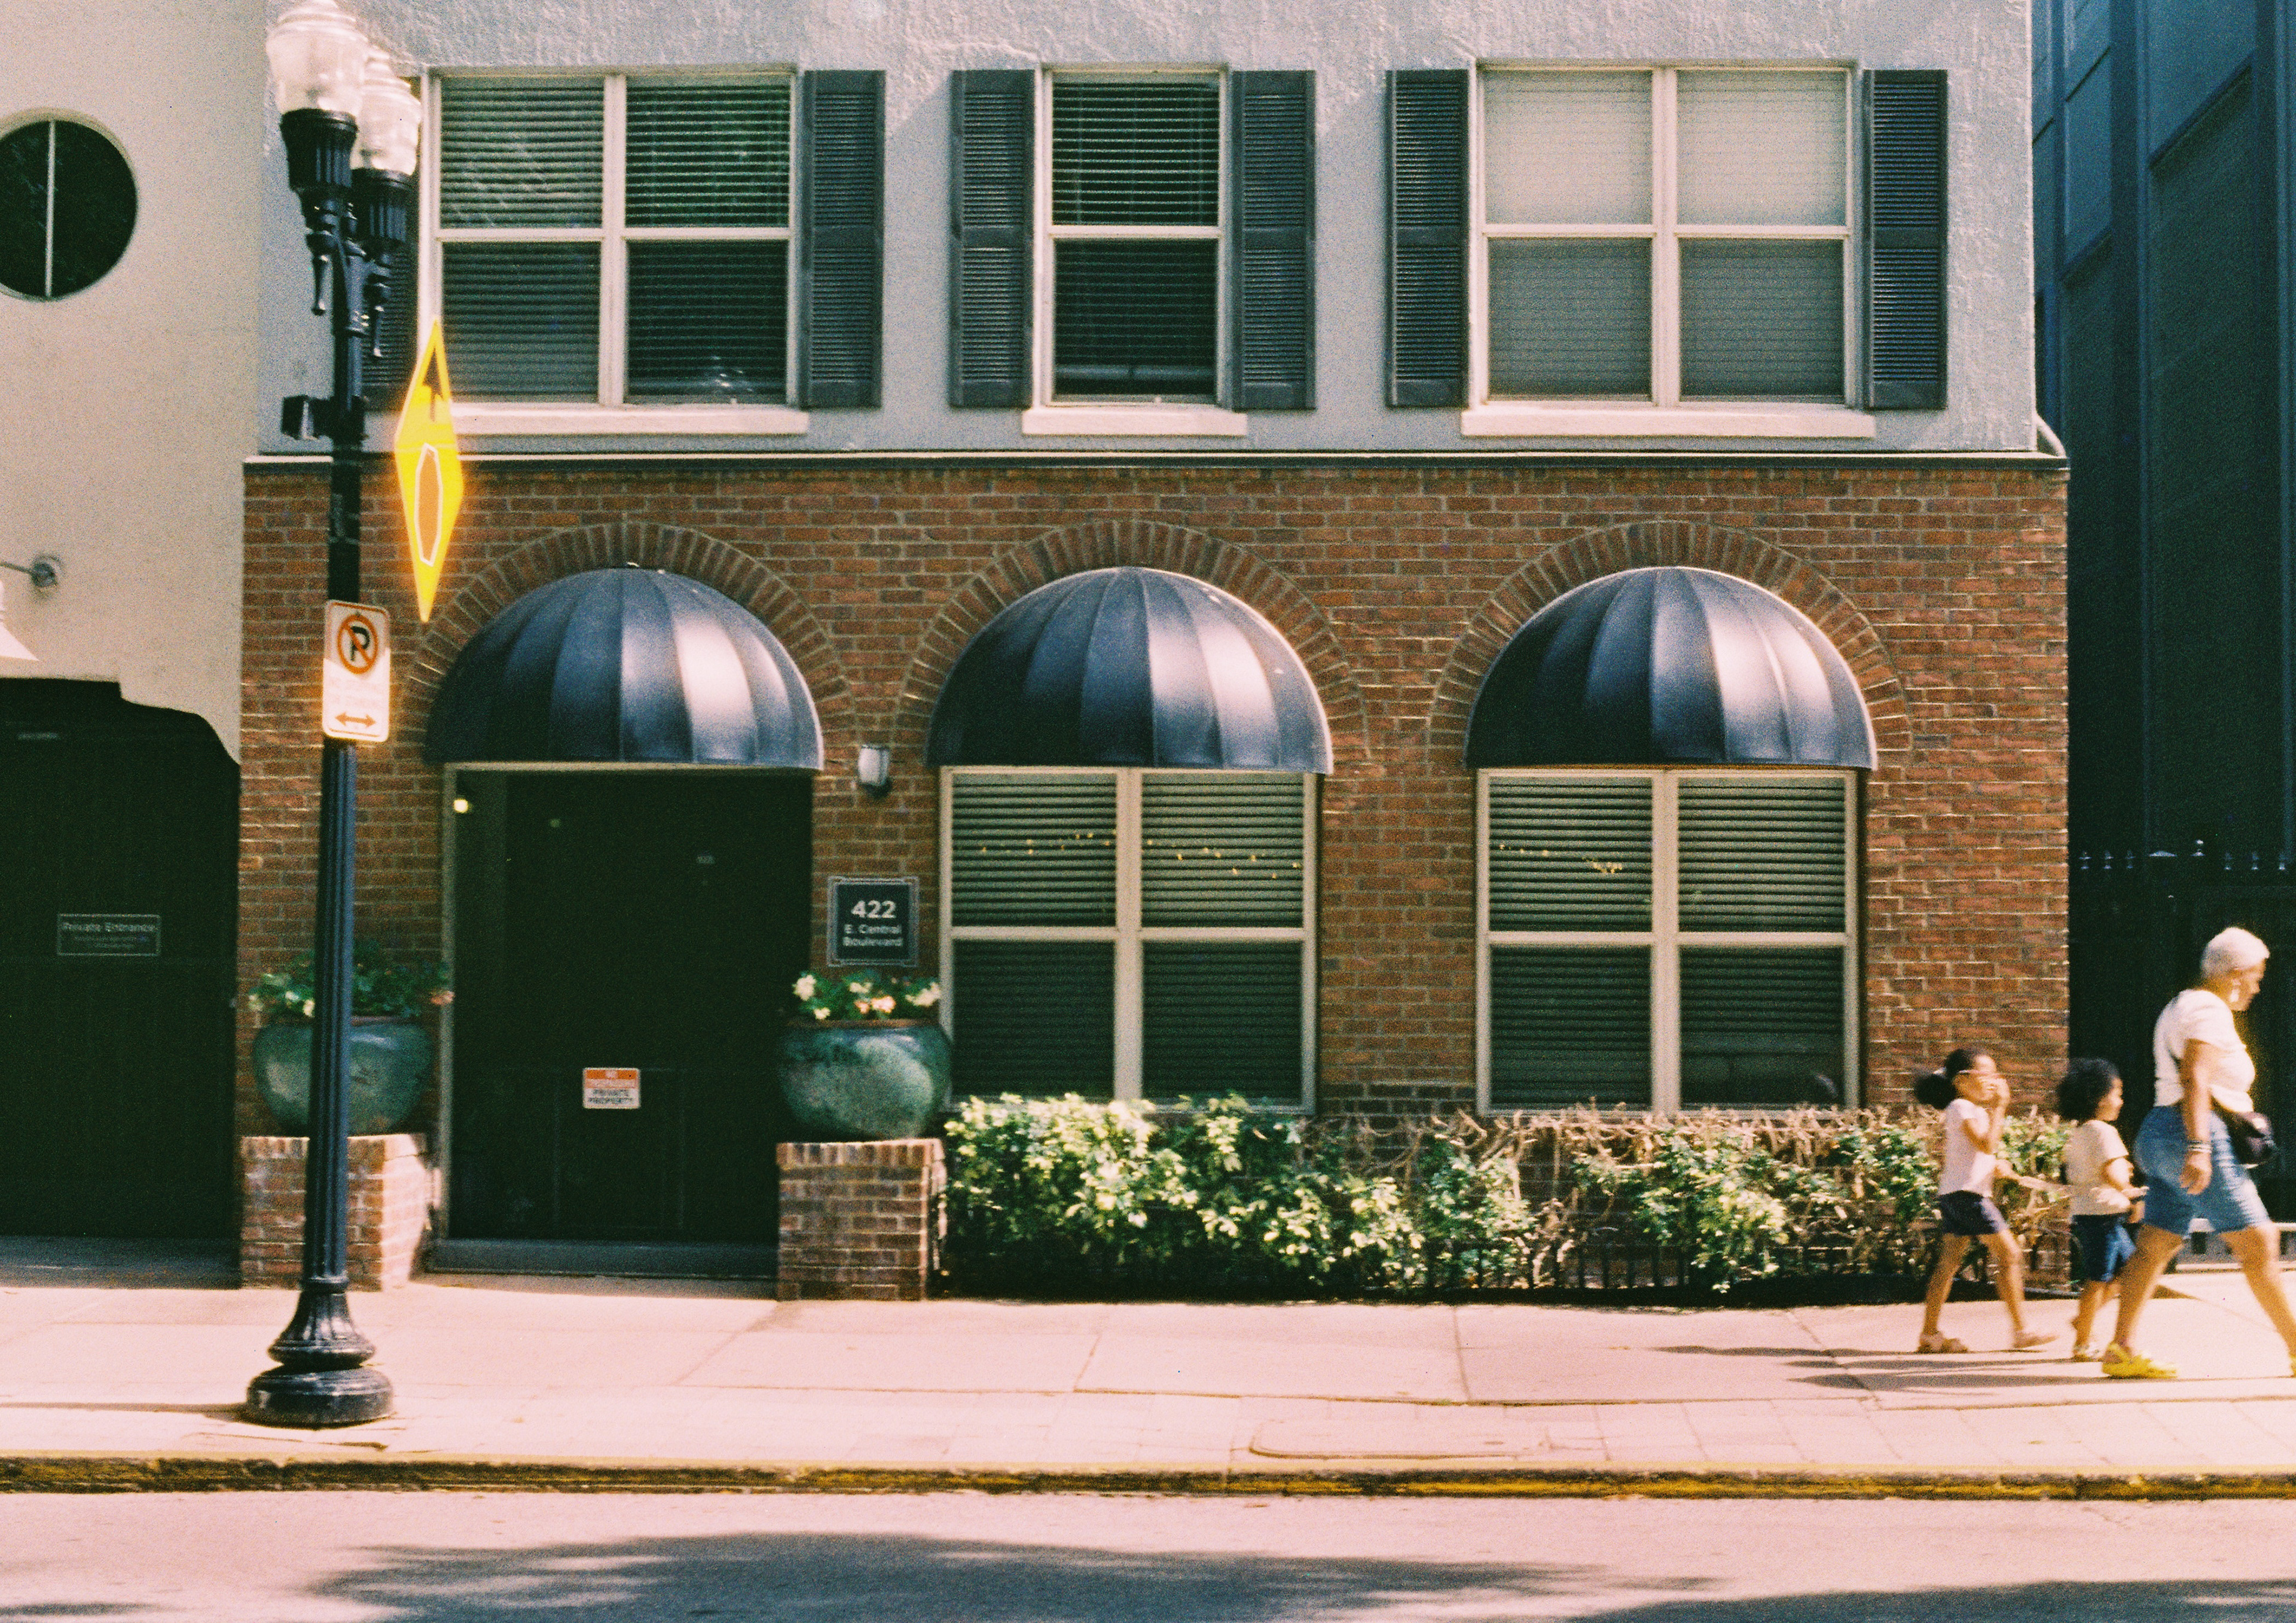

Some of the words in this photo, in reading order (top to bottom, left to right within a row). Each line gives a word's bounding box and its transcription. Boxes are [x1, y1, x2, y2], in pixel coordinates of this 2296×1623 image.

[851, 900, 896, 919] 422
[858, 924, 902, 934] Central
[842, 936, 903, 946] Boulevard
